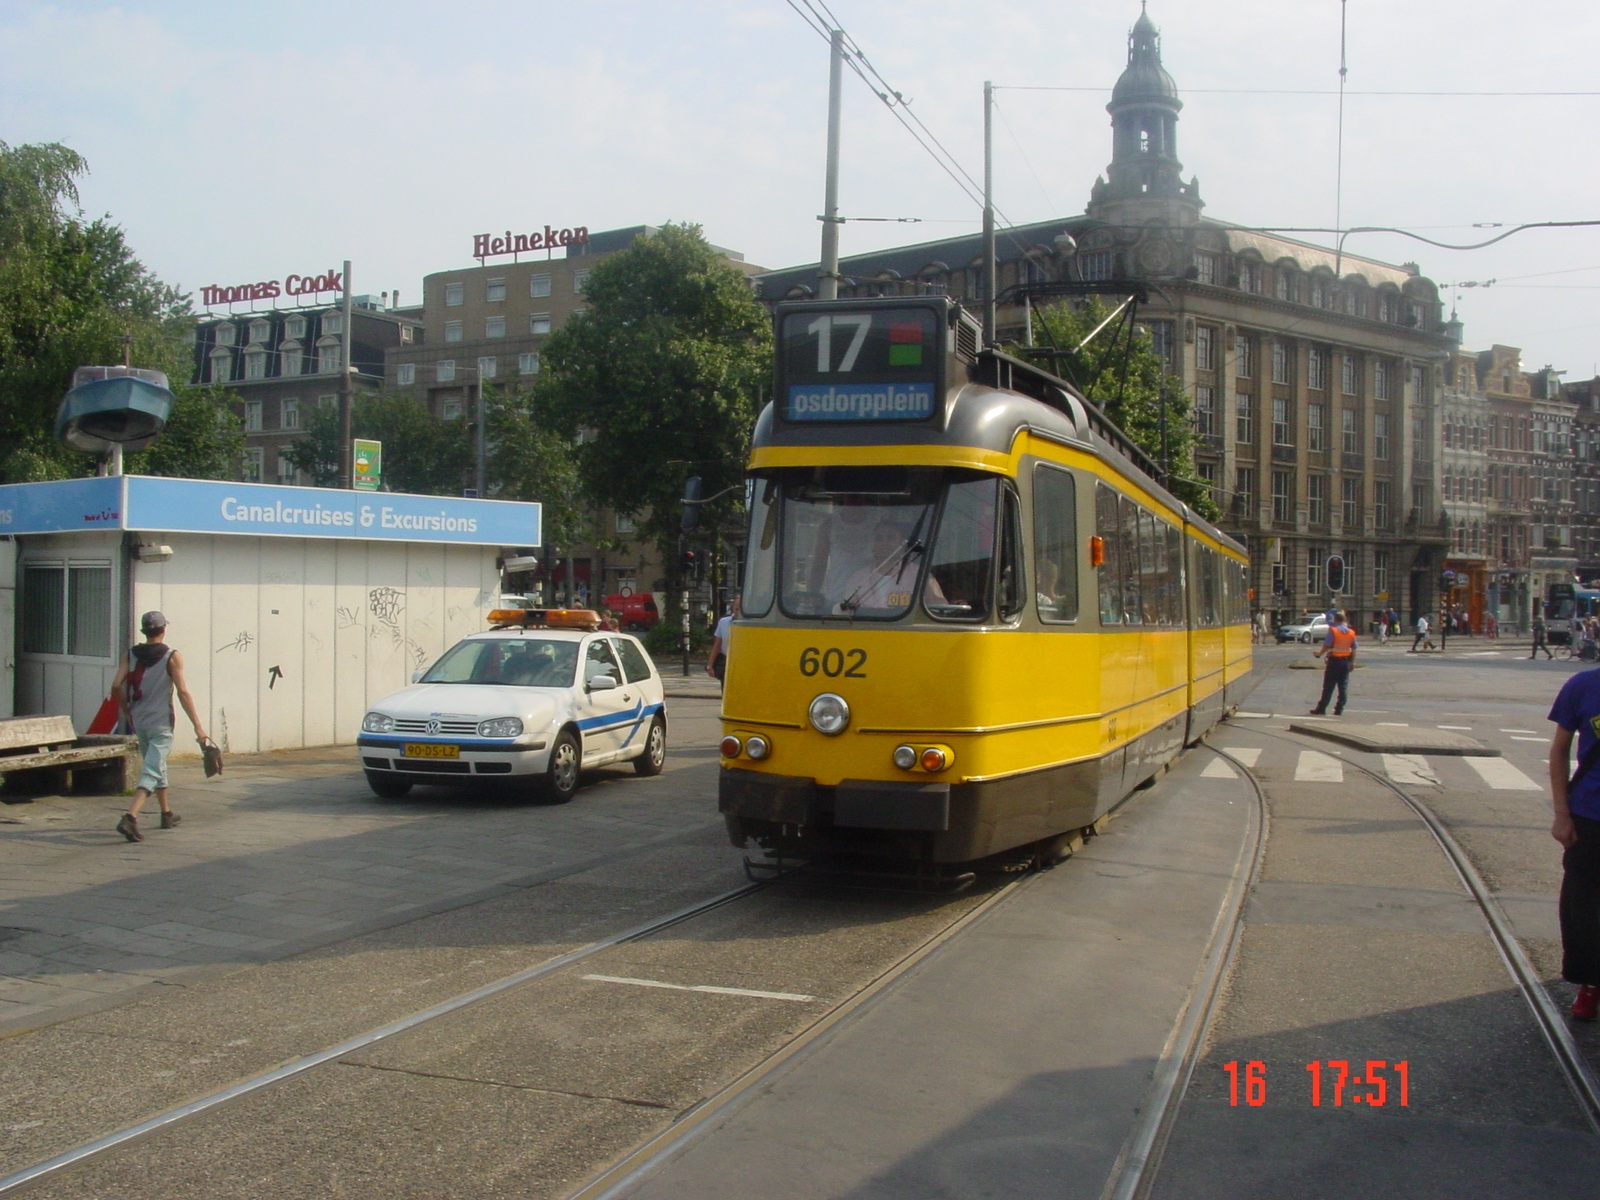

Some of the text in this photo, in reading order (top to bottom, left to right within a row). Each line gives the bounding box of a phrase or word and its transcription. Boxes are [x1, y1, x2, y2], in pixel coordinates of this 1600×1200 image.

[473, 225, 589, 258] Heineken
[200, 269, 344, 306] Thomas Cook
[808, 315, 872, 373] 17
[794, 386, 929, 418] osdorpplein
[221, 497, 478, 533] Canalcruises & Excursions
[800, 647, 868, 679] 602
